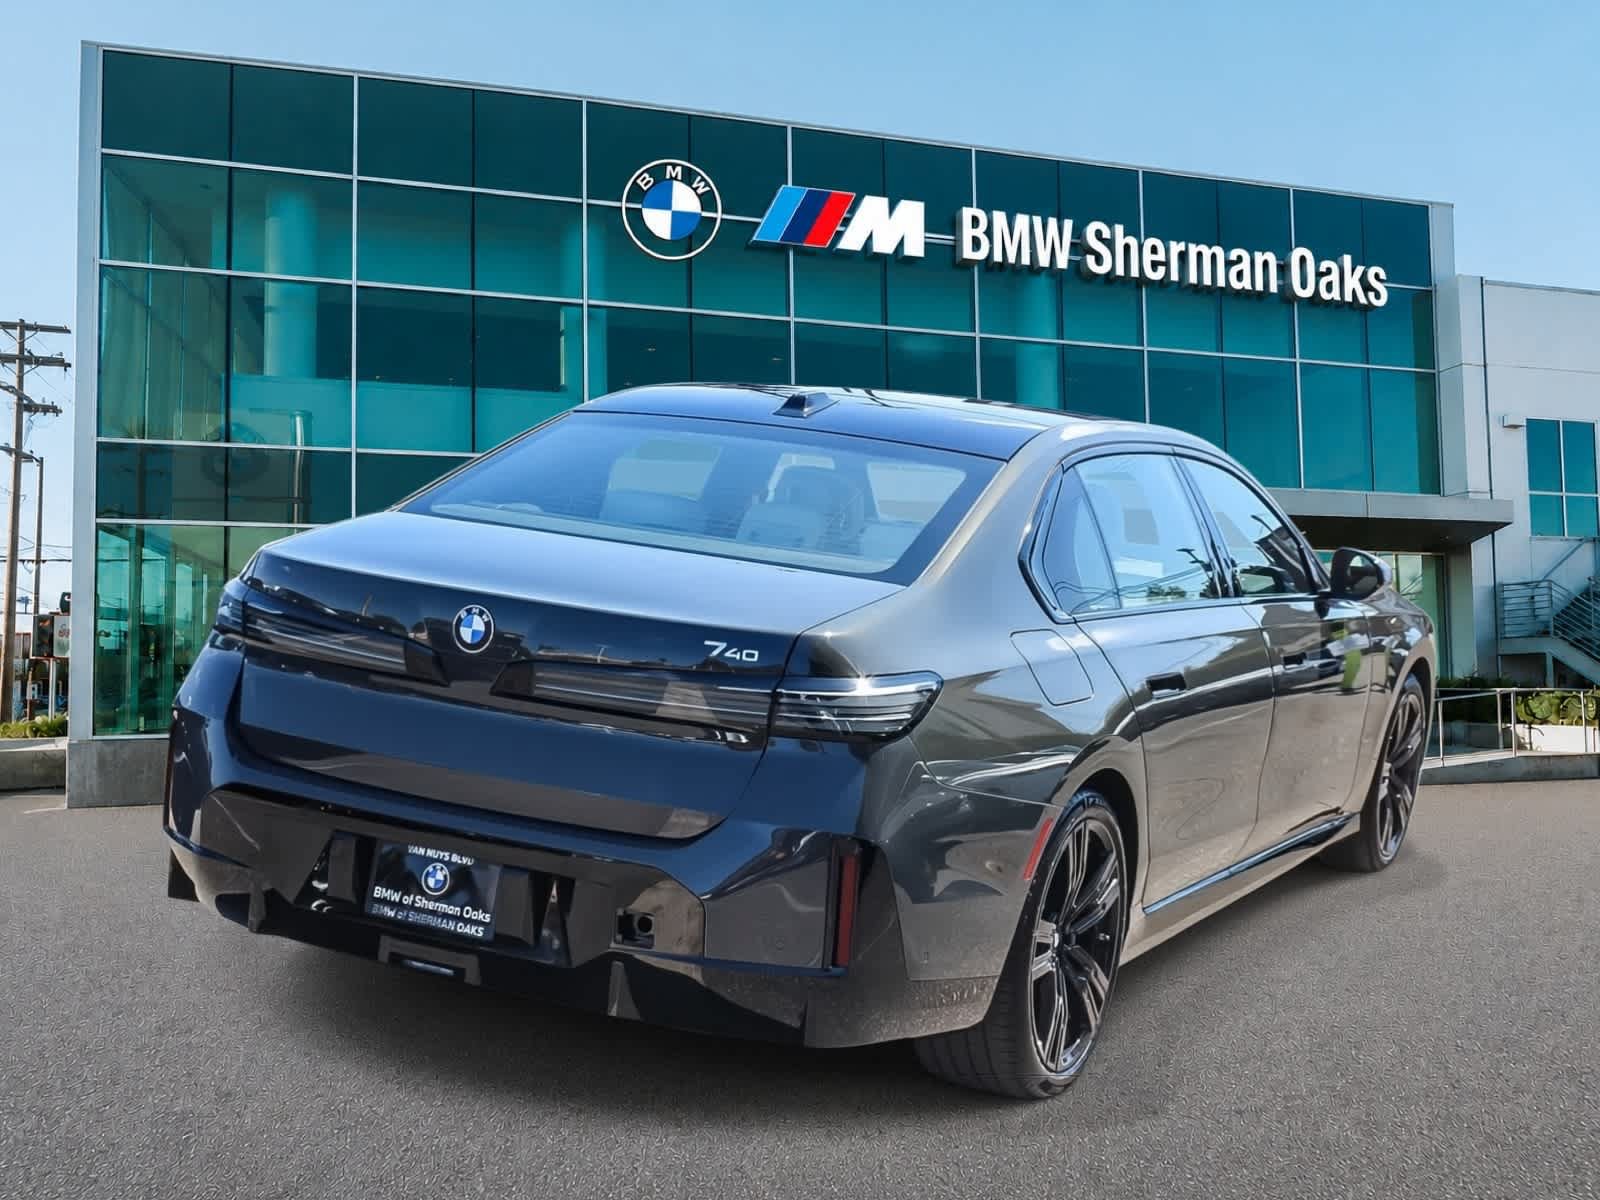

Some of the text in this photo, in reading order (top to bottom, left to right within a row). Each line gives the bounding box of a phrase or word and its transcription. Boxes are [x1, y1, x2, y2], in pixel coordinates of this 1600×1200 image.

[636, 165, 711, 195] BMW
[835, 194, 925, 258] M
[961, 206, 1388, 308] BMW Sherman Oaks
[703, 640, 759, 662] 740
[408, 844, 474, 866] VAN NUYS BLVD
[371, 903, 485, 937] BMW of SHERMAN OAKS
[373, 886, 491, 923] BMW of Sherman Oaks
